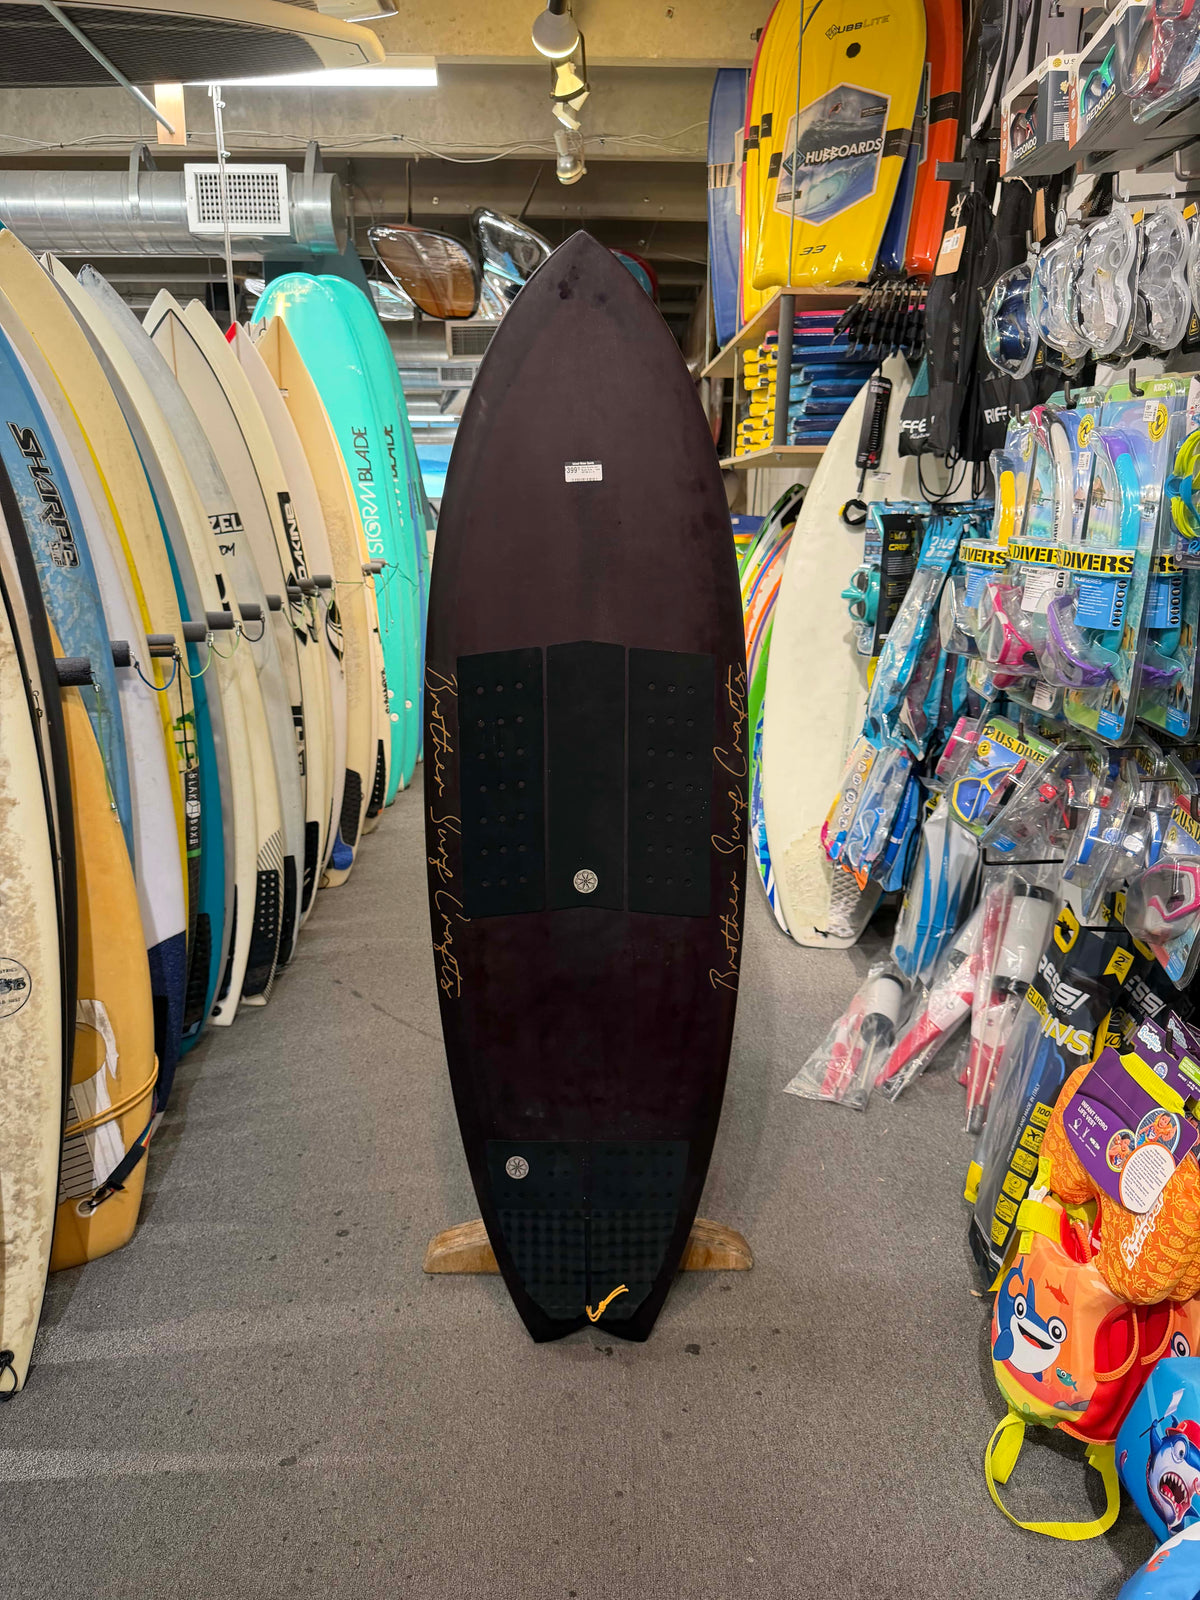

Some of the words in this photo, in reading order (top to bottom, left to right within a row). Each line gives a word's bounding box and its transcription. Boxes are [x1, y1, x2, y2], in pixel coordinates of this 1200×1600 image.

[1086, 84, 1117, 124] REDONDO
[805, 138, 884, 164] HUBBOARDS
[1013, 136, 1038, 161] REDONDO
[800, 245, 827, 256] 33
[1079, 395, 1097, 405] ADULT
[351, 425, 385, 554] STORMBLADE
[285, 502, 310, 581] DAKINE
[1062, 550, 1135, 573] DIVERS
[713, 662, 749, 778] Crafts
[996, 731, 1014, 753] U.S.
[711, 784, 749, 860] Surf
[709, 871, 741, 992] Brother
[1077, 1105, 1086, 1118] LIFE
[1085, 1114, 1097, 1128] VEST
[1080, 1100, 1096, 1117] INFANT
[1093, 1114, 1109, 1131] HYDRO
